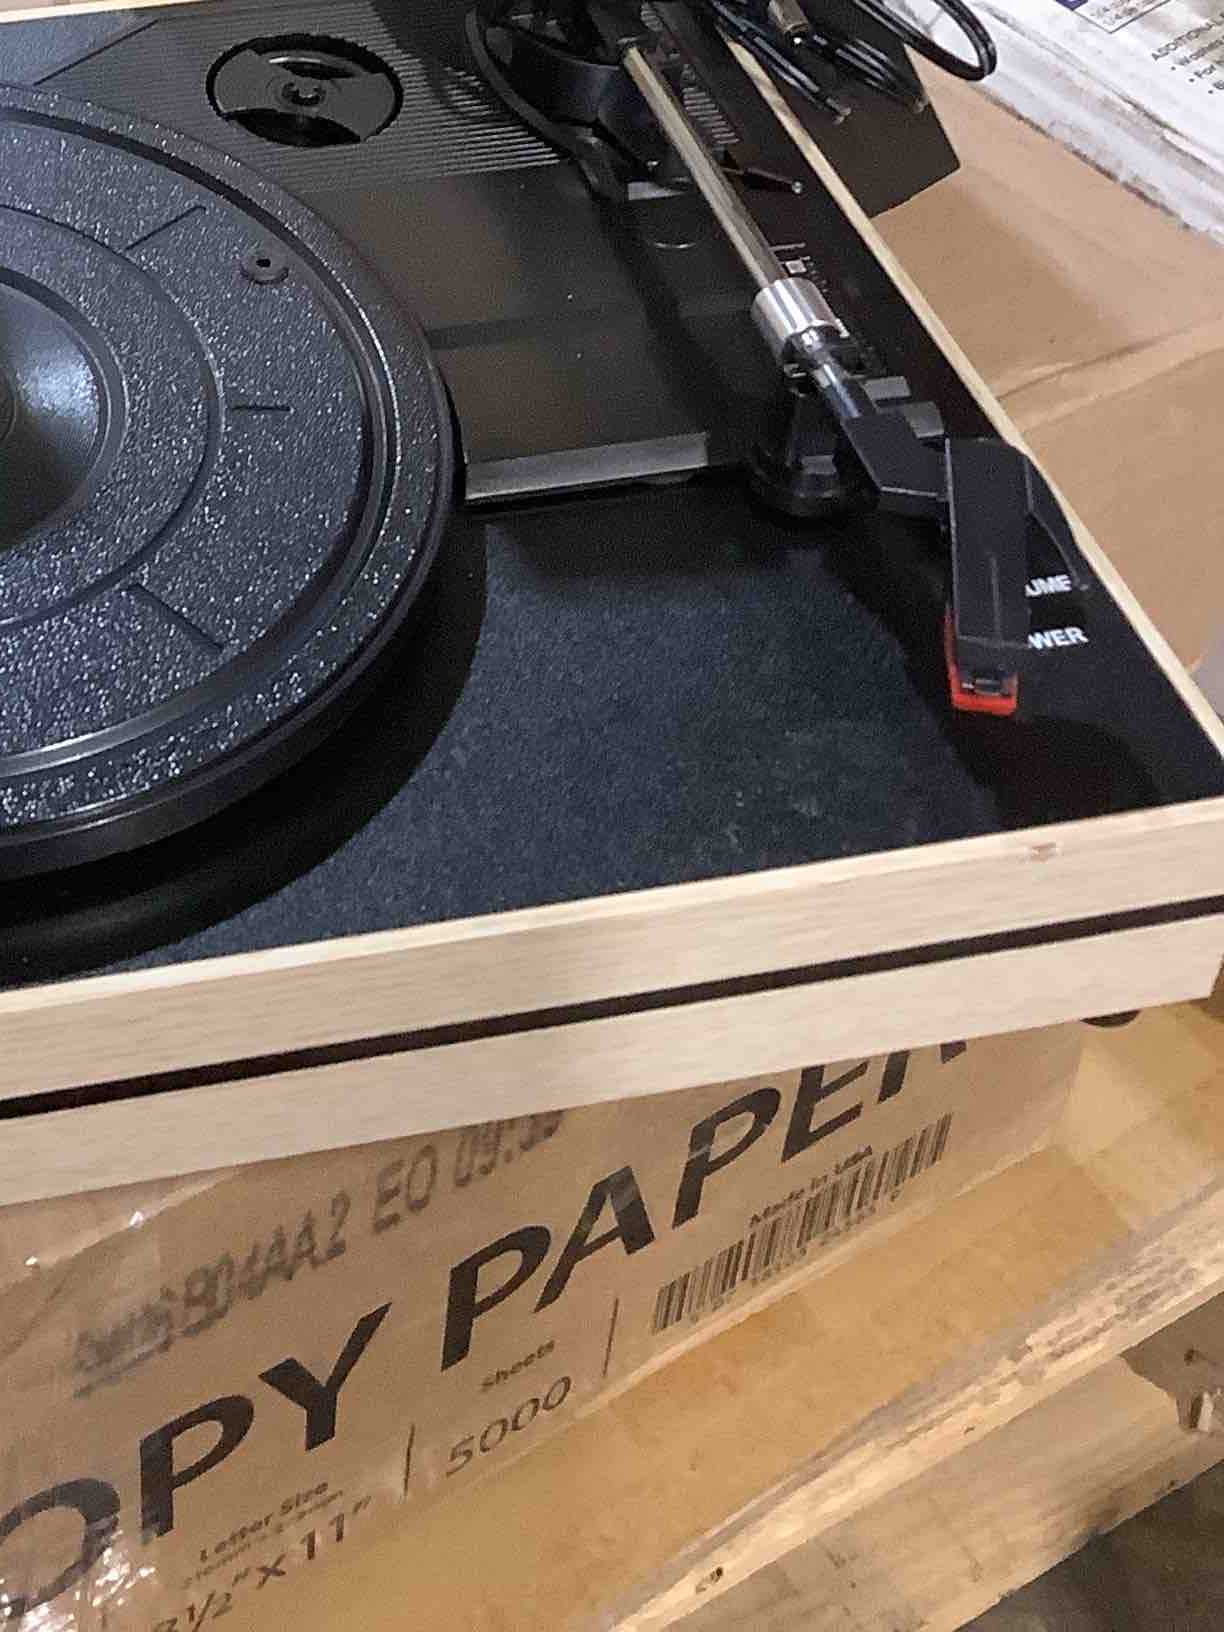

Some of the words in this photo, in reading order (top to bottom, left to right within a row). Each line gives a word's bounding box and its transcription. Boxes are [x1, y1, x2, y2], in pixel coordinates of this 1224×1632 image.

[1027, 627, 1089, 651] WER
[445, 1375, 573, 1478] 5000
[199, 1512, 274, 1563] Letter
